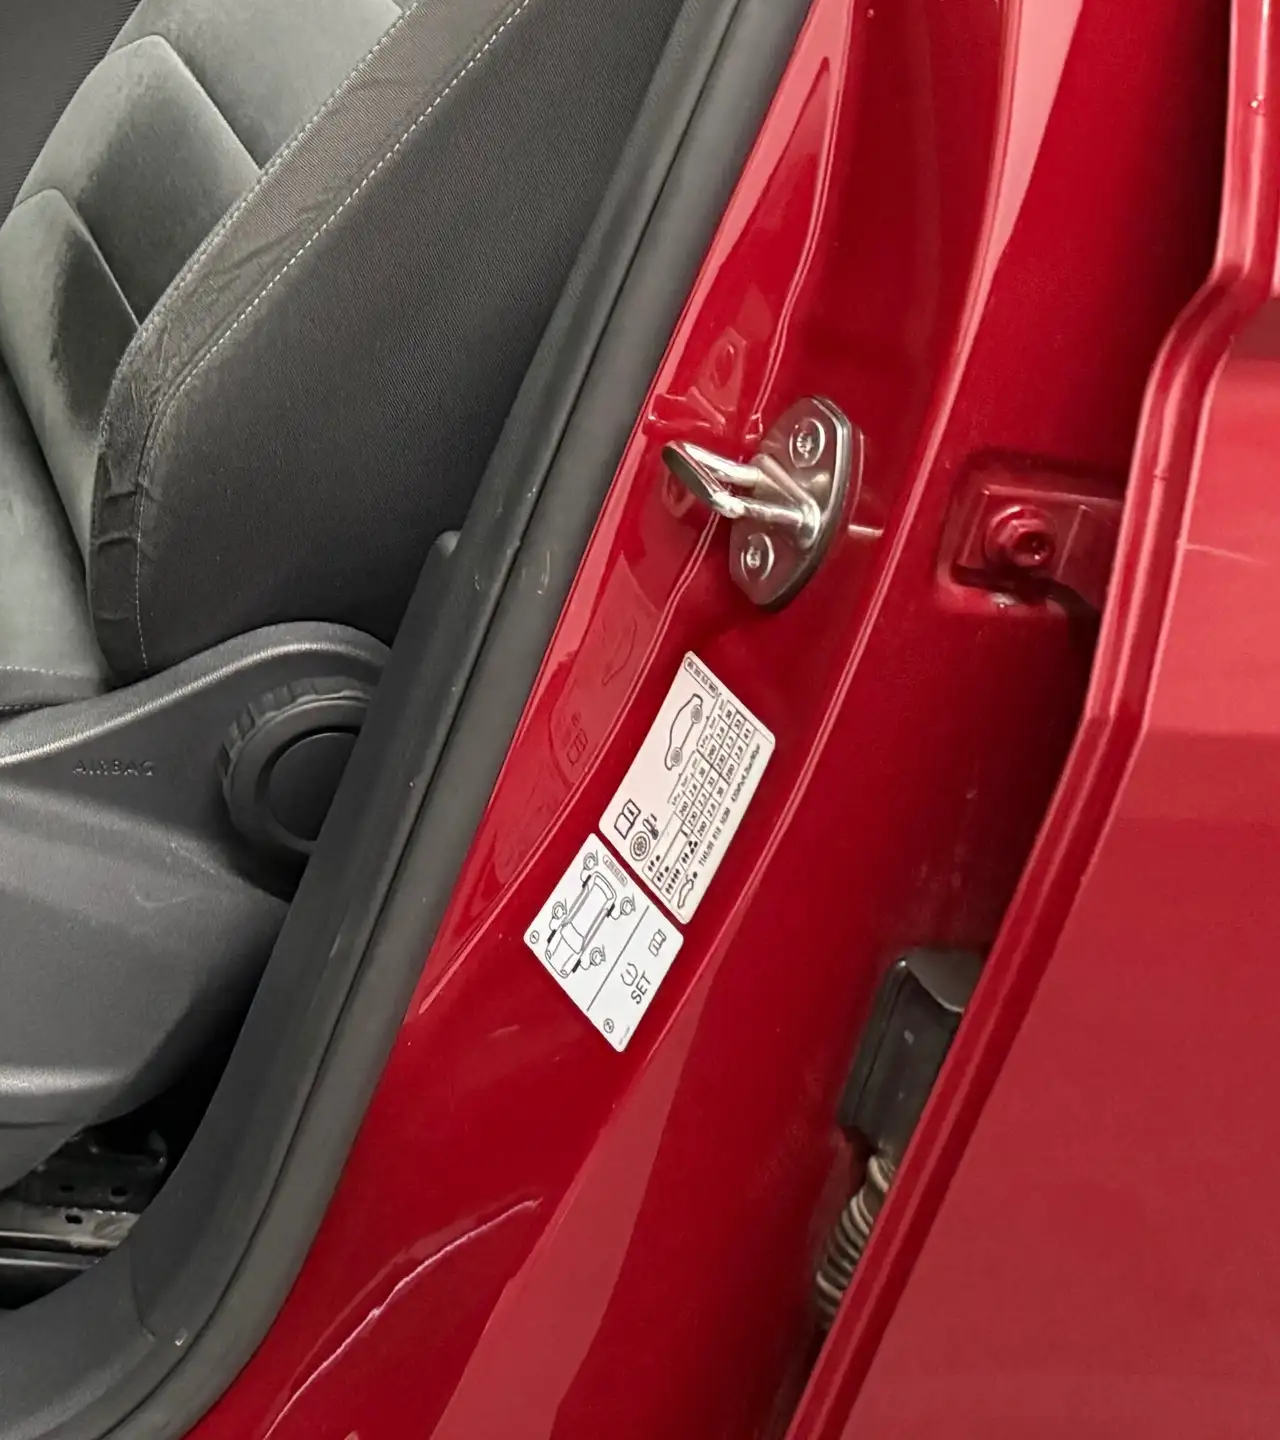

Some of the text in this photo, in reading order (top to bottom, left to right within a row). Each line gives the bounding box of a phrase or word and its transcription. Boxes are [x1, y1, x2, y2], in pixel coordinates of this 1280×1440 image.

[742, 727, 751, 740] 41
[72, 759, 156, 777] AIRBAG
[687, 809, 698, 827] 230
[715, 753, 726, 770] 230
[630, 971, 652, 1006] SET
